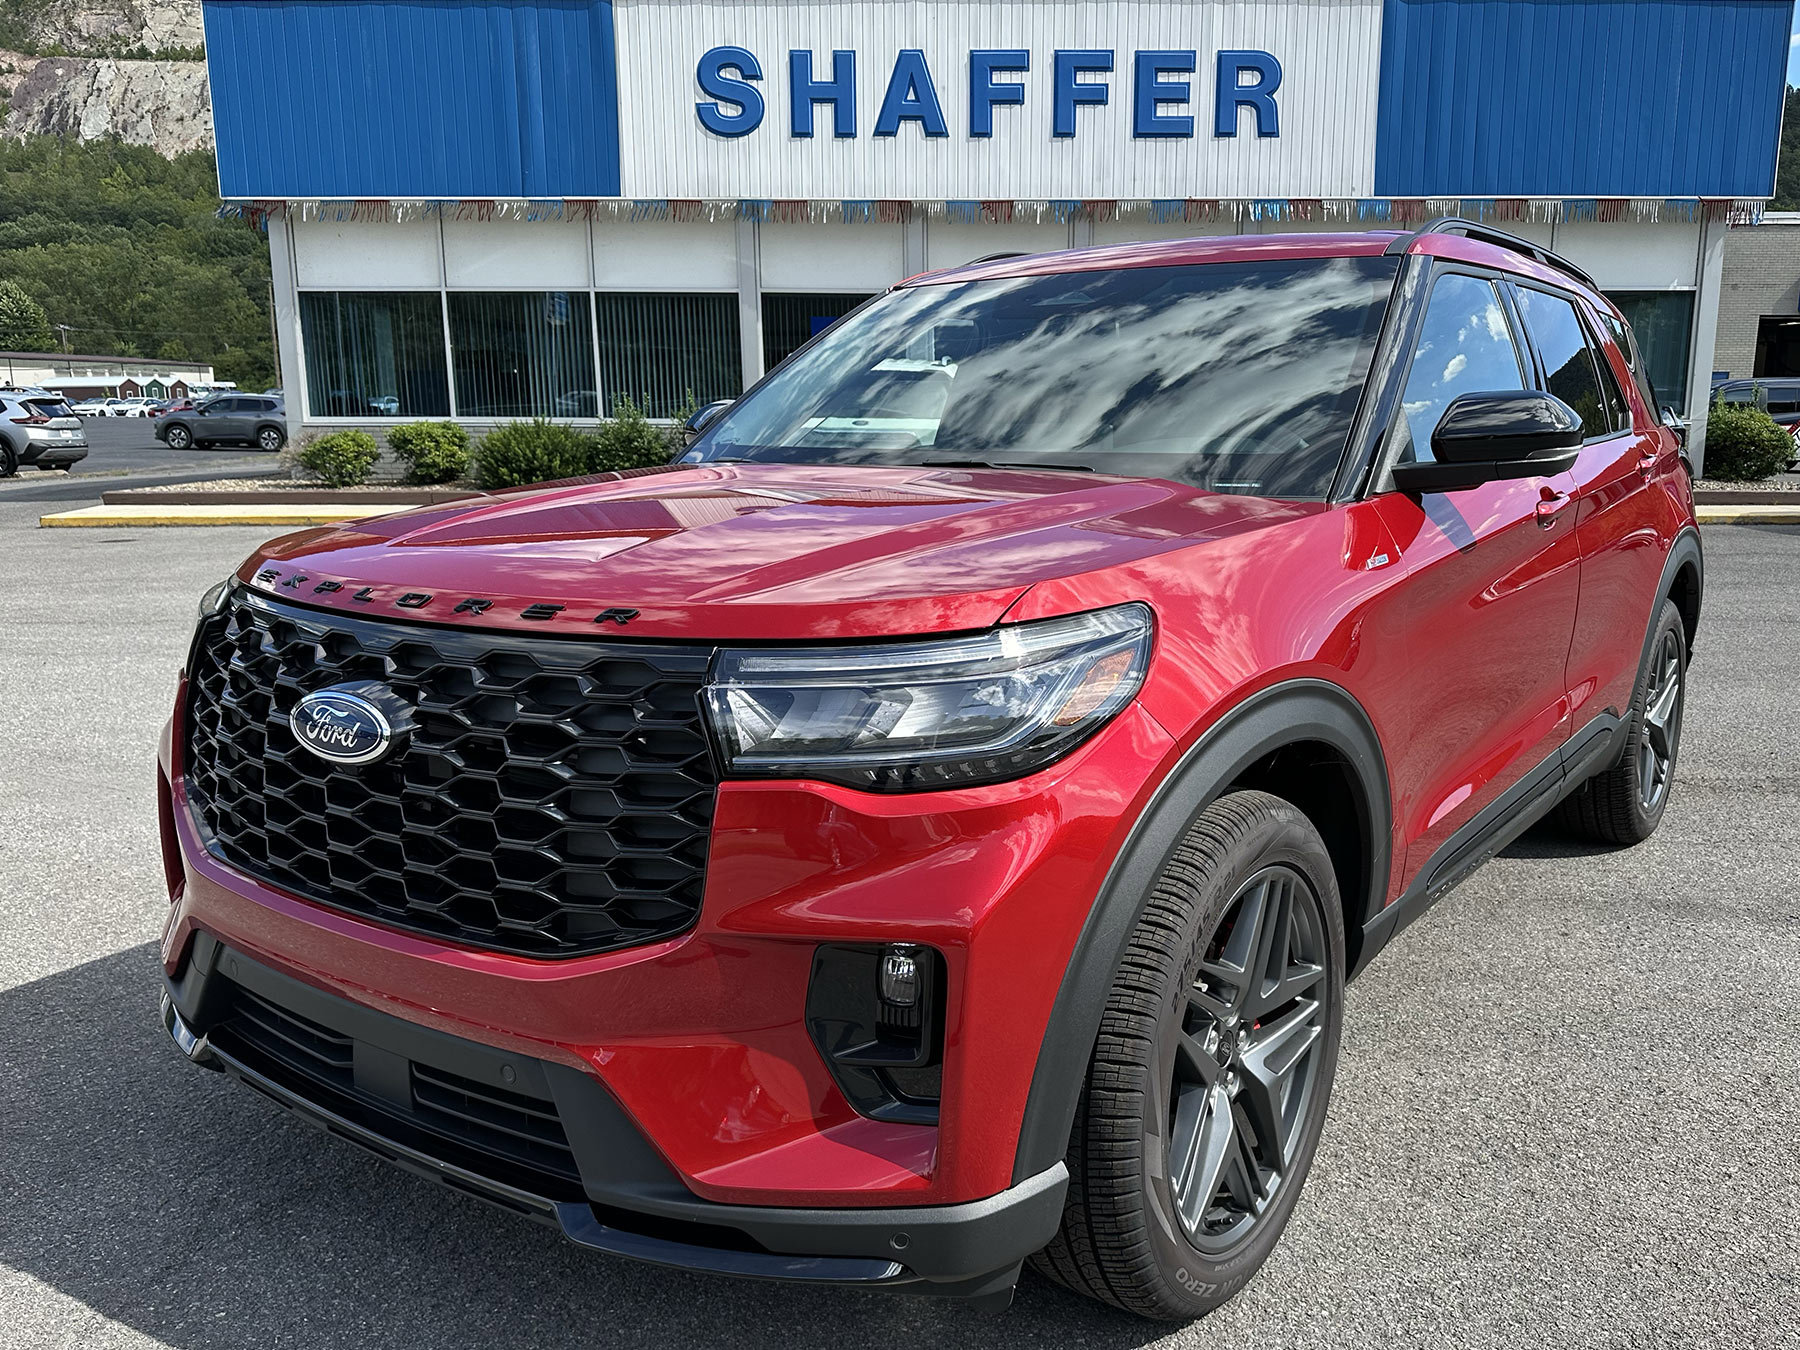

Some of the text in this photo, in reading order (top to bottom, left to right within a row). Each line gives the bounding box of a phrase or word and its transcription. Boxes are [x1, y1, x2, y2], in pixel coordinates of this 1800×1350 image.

[695, 45, 1284, 138] SHAFFER
[256, 568, 641, 626] EXPLORER
[305, 704, 358, 749] Ford
[1171, 905, 1211, 1015] 275/45
[1175, 1266, 1218, 1298] ZERO
